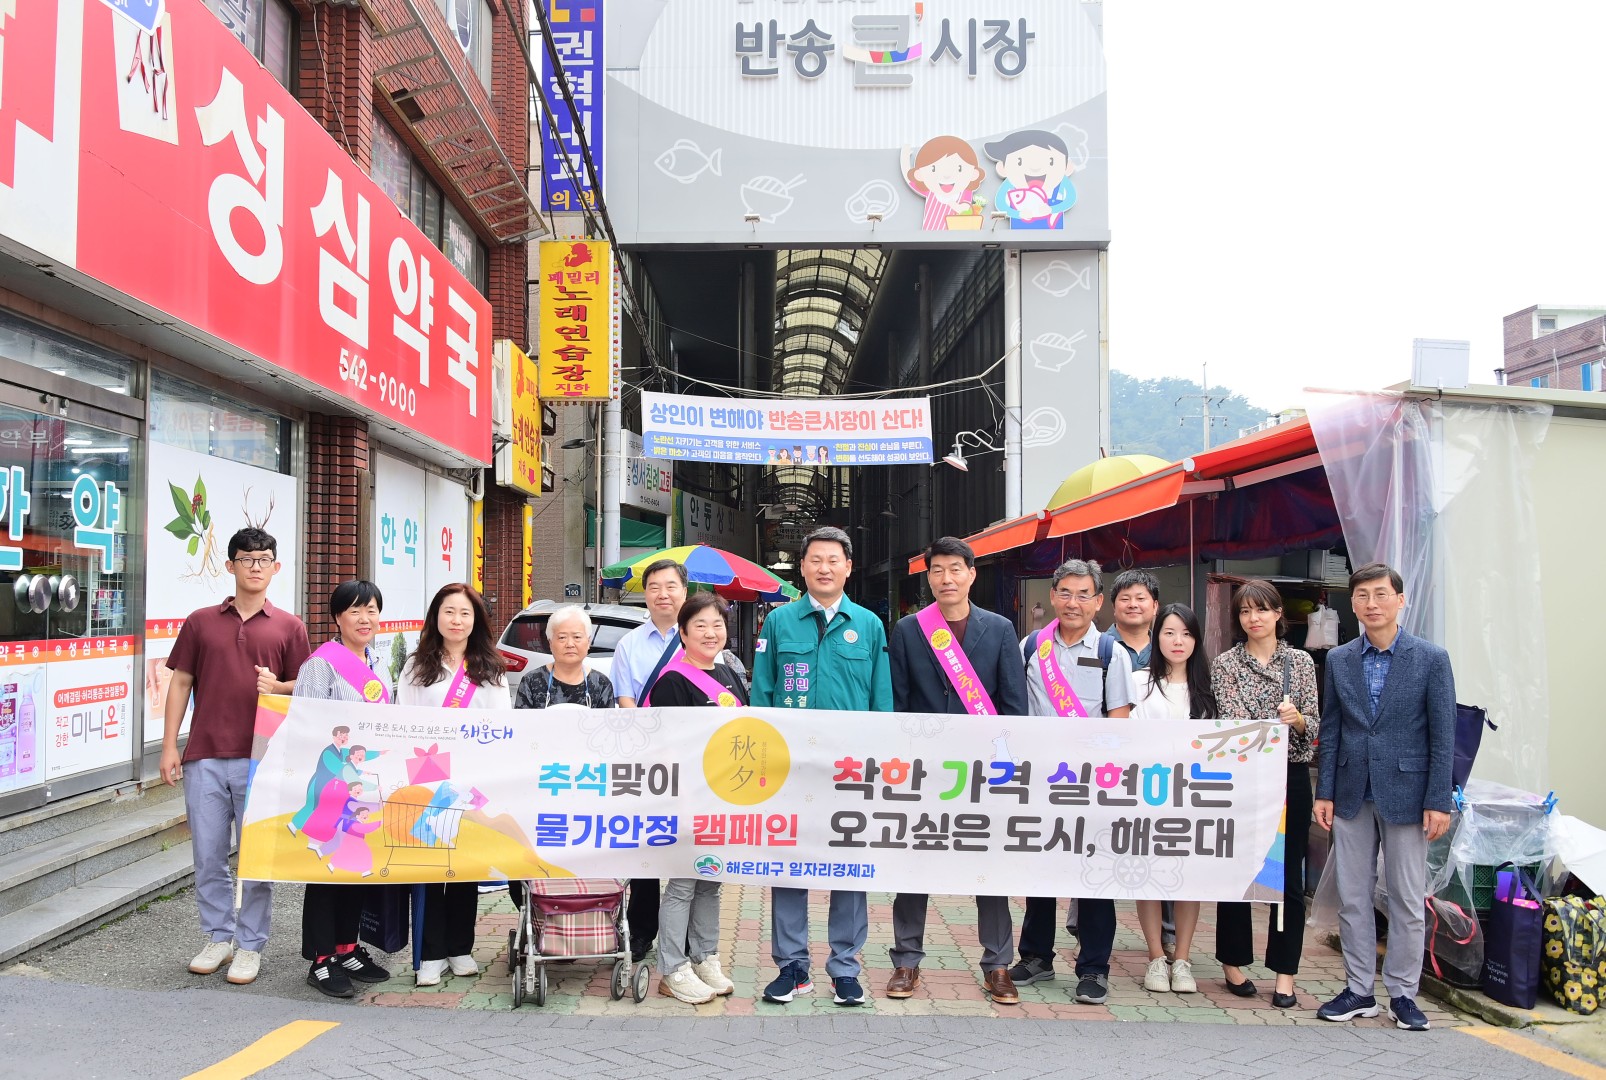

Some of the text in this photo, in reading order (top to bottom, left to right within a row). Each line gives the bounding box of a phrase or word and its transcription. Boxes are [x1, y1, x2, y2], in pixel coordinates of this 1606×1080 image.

[550, 30, 598, 188] 권혁내과
[194, 66, 480, 418] 성심약국
[552, 285, 593, 382] 노래연습장
[338, 347, 417, 417] 542-9000
[554, 383, 590, 391] 지하
[511, 408, 540, 462] 노래연습장
[650, 402, 923, 432] 상인이 변해야 반송큰시장이 산다!
[726, 440, 740, 449] 위한
[741, 441, 761, 450] 서비스
[381, 513, 418, 568] 한약
[442, 526, 453, 572] 약
[68, 639, 118, 658] 성심약국
[71, 704, 119, 744] 미니온
[358, 721, 513, 745] 살기 좋은 도시, 오고 싶은 도시 해운대
[538, 762, 680, 797] 추석맞이
[729, 734, 757, 793] 秋夕
[833, 756, 1234, 808] 착한 가격 실현하는
[535, 813, 799, 848] 물가안정 캠페인
[828, 810, 1236, 858] 오고싶은 도시, 해운대
[726, 861, 876, 879] 해운대구 일자리경제과
